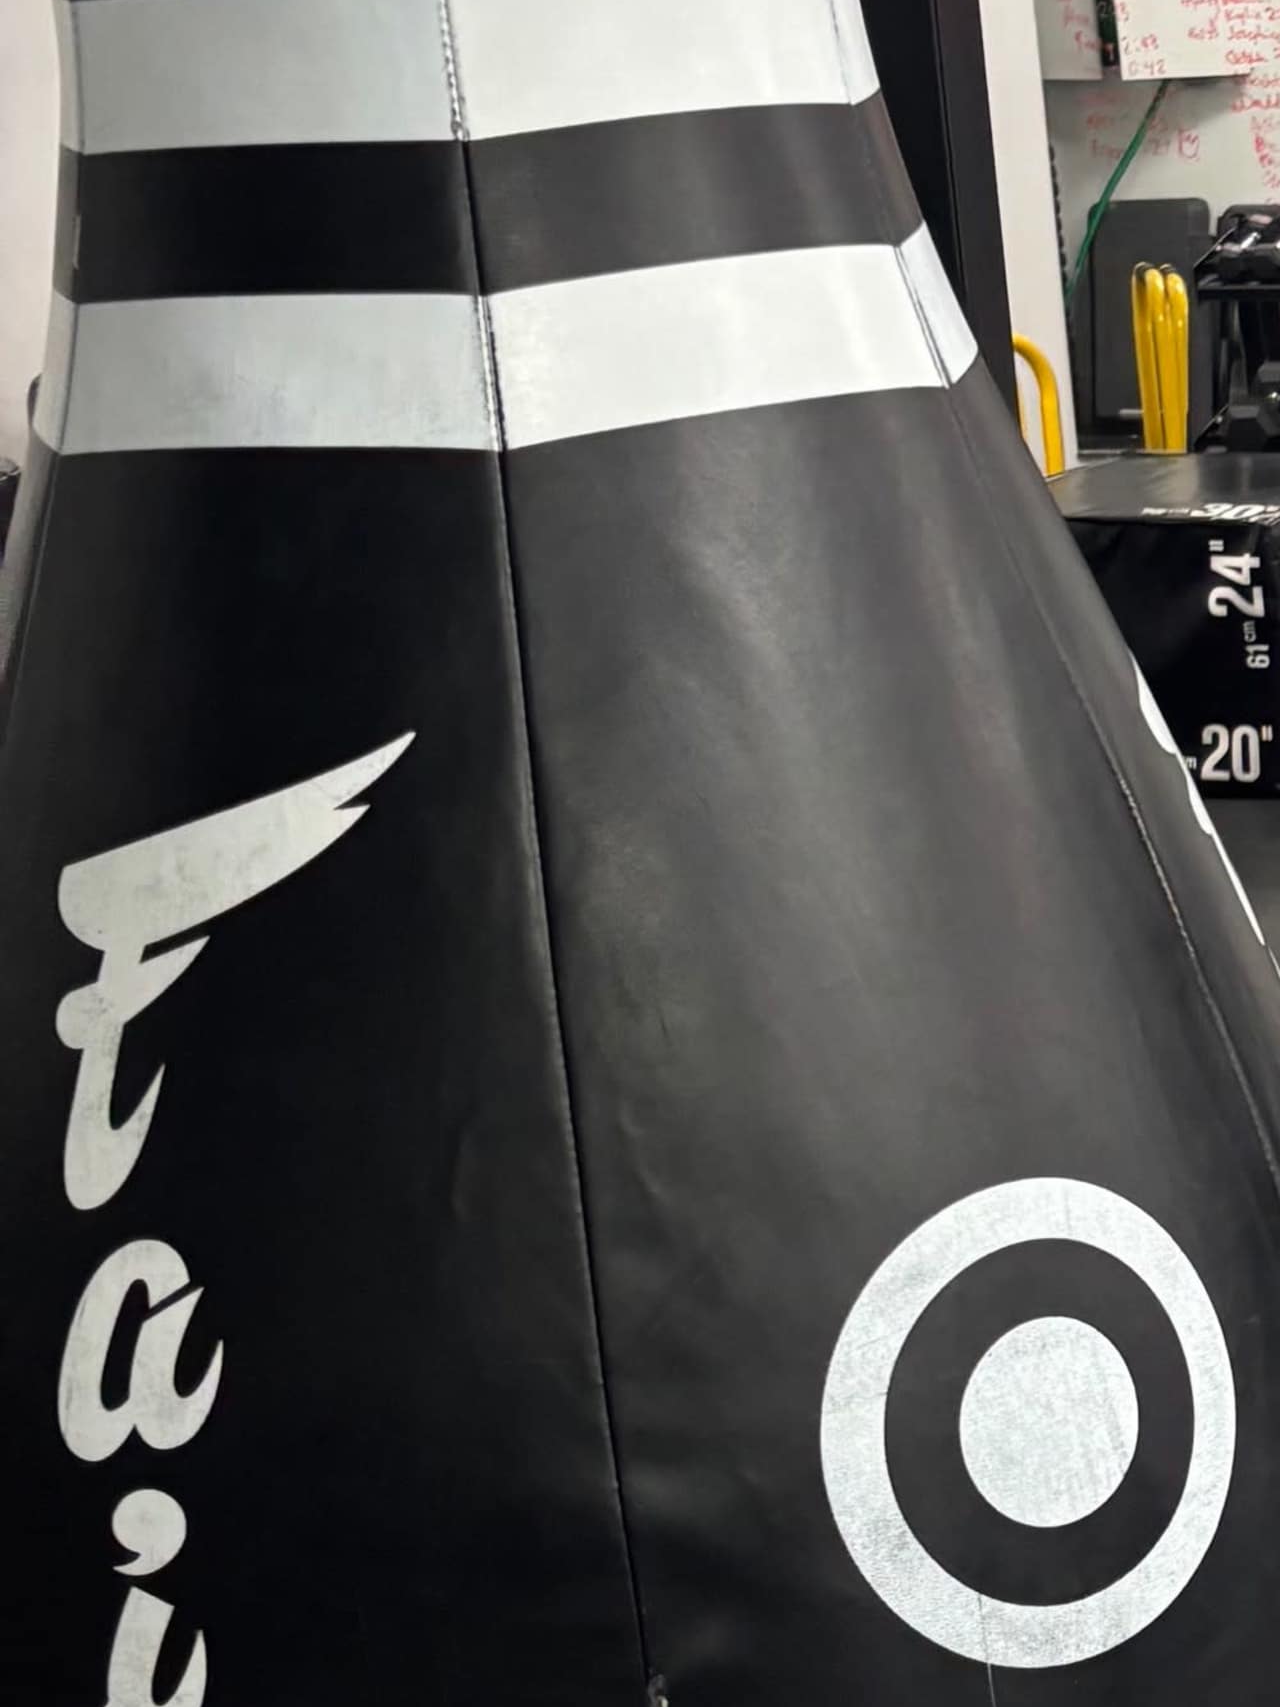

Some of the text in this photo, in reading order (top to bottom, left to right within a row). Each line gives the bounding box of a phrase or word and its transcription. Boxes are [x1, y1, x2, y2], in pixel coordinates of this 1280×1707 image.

[1207, 539, 1270, 669] 61 cm 24"
[1200, 723, 1274, 783] 20"
